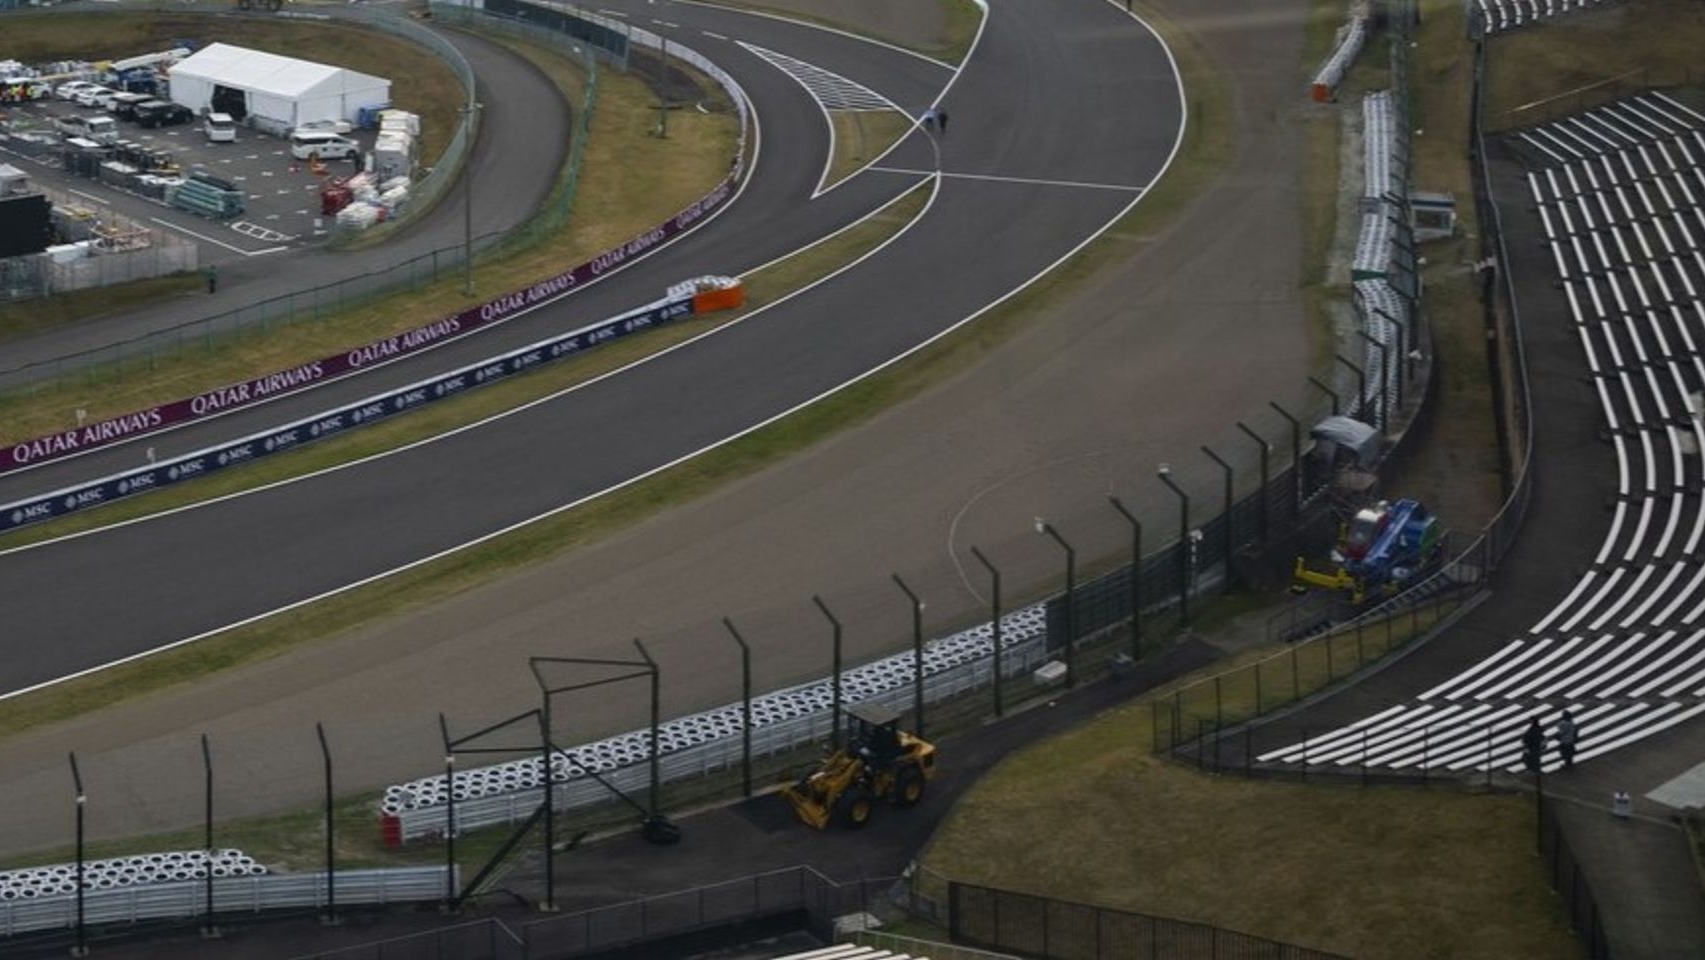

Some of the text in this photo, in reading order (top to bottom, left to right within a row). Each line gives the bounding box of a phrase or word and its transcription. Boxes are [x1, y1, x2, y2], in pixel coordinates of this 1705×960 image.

[348, 338, 399, 366] QATAR
[191, 361, 324, 414] QATAR AIRWAYS
[13, 408, 162, 463] QATAR AIRWAYS
[228, 443, 253, 461] MSC
[178, 458, 206, 475] MSC
[129, 473, 157, 490] MSC
[77, 487, 104, 504] MSC
[24, 502, 52, 519] MSC
